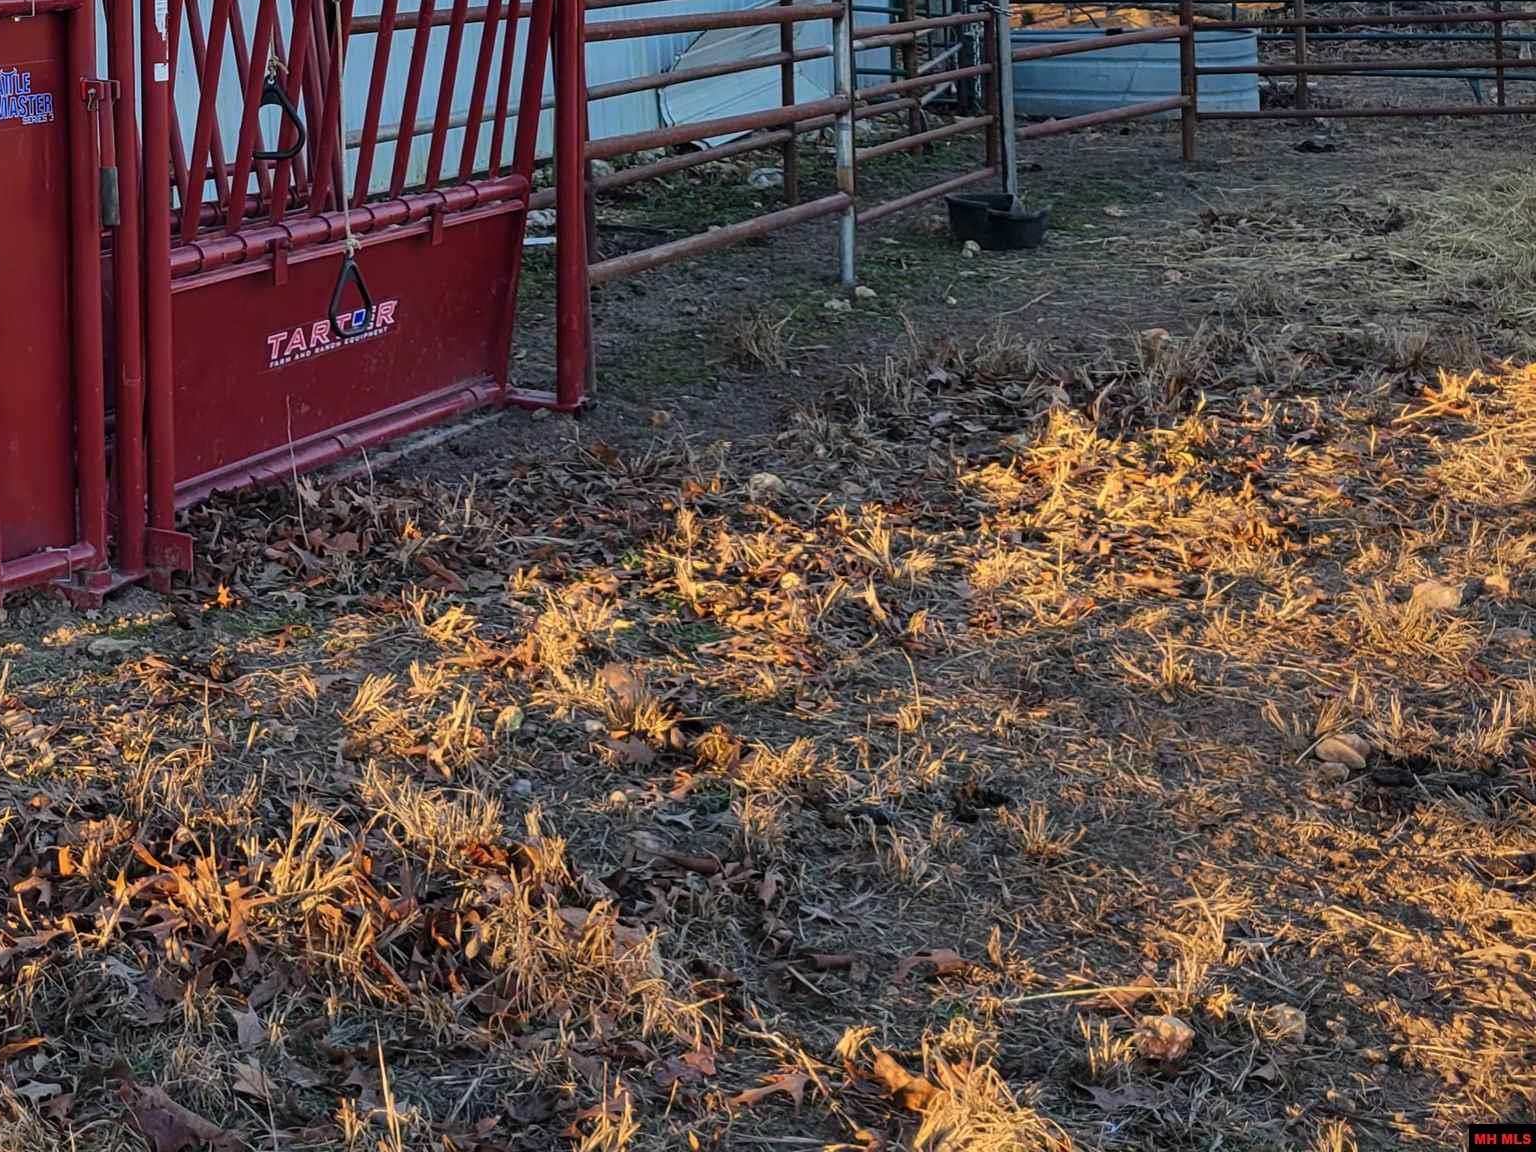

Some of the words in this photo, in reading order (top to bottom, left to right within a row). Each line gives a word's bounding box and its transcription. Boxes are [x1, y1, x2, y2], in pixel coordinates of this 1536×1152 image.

[22, 114, 47, 125] SERIES
[269, 356, 291, 368] FARM
[293, 350, 312, 361] AND
[314, 341, 342, 354] RANCH
[344, 326, 389, 345] EQUIPMENT
